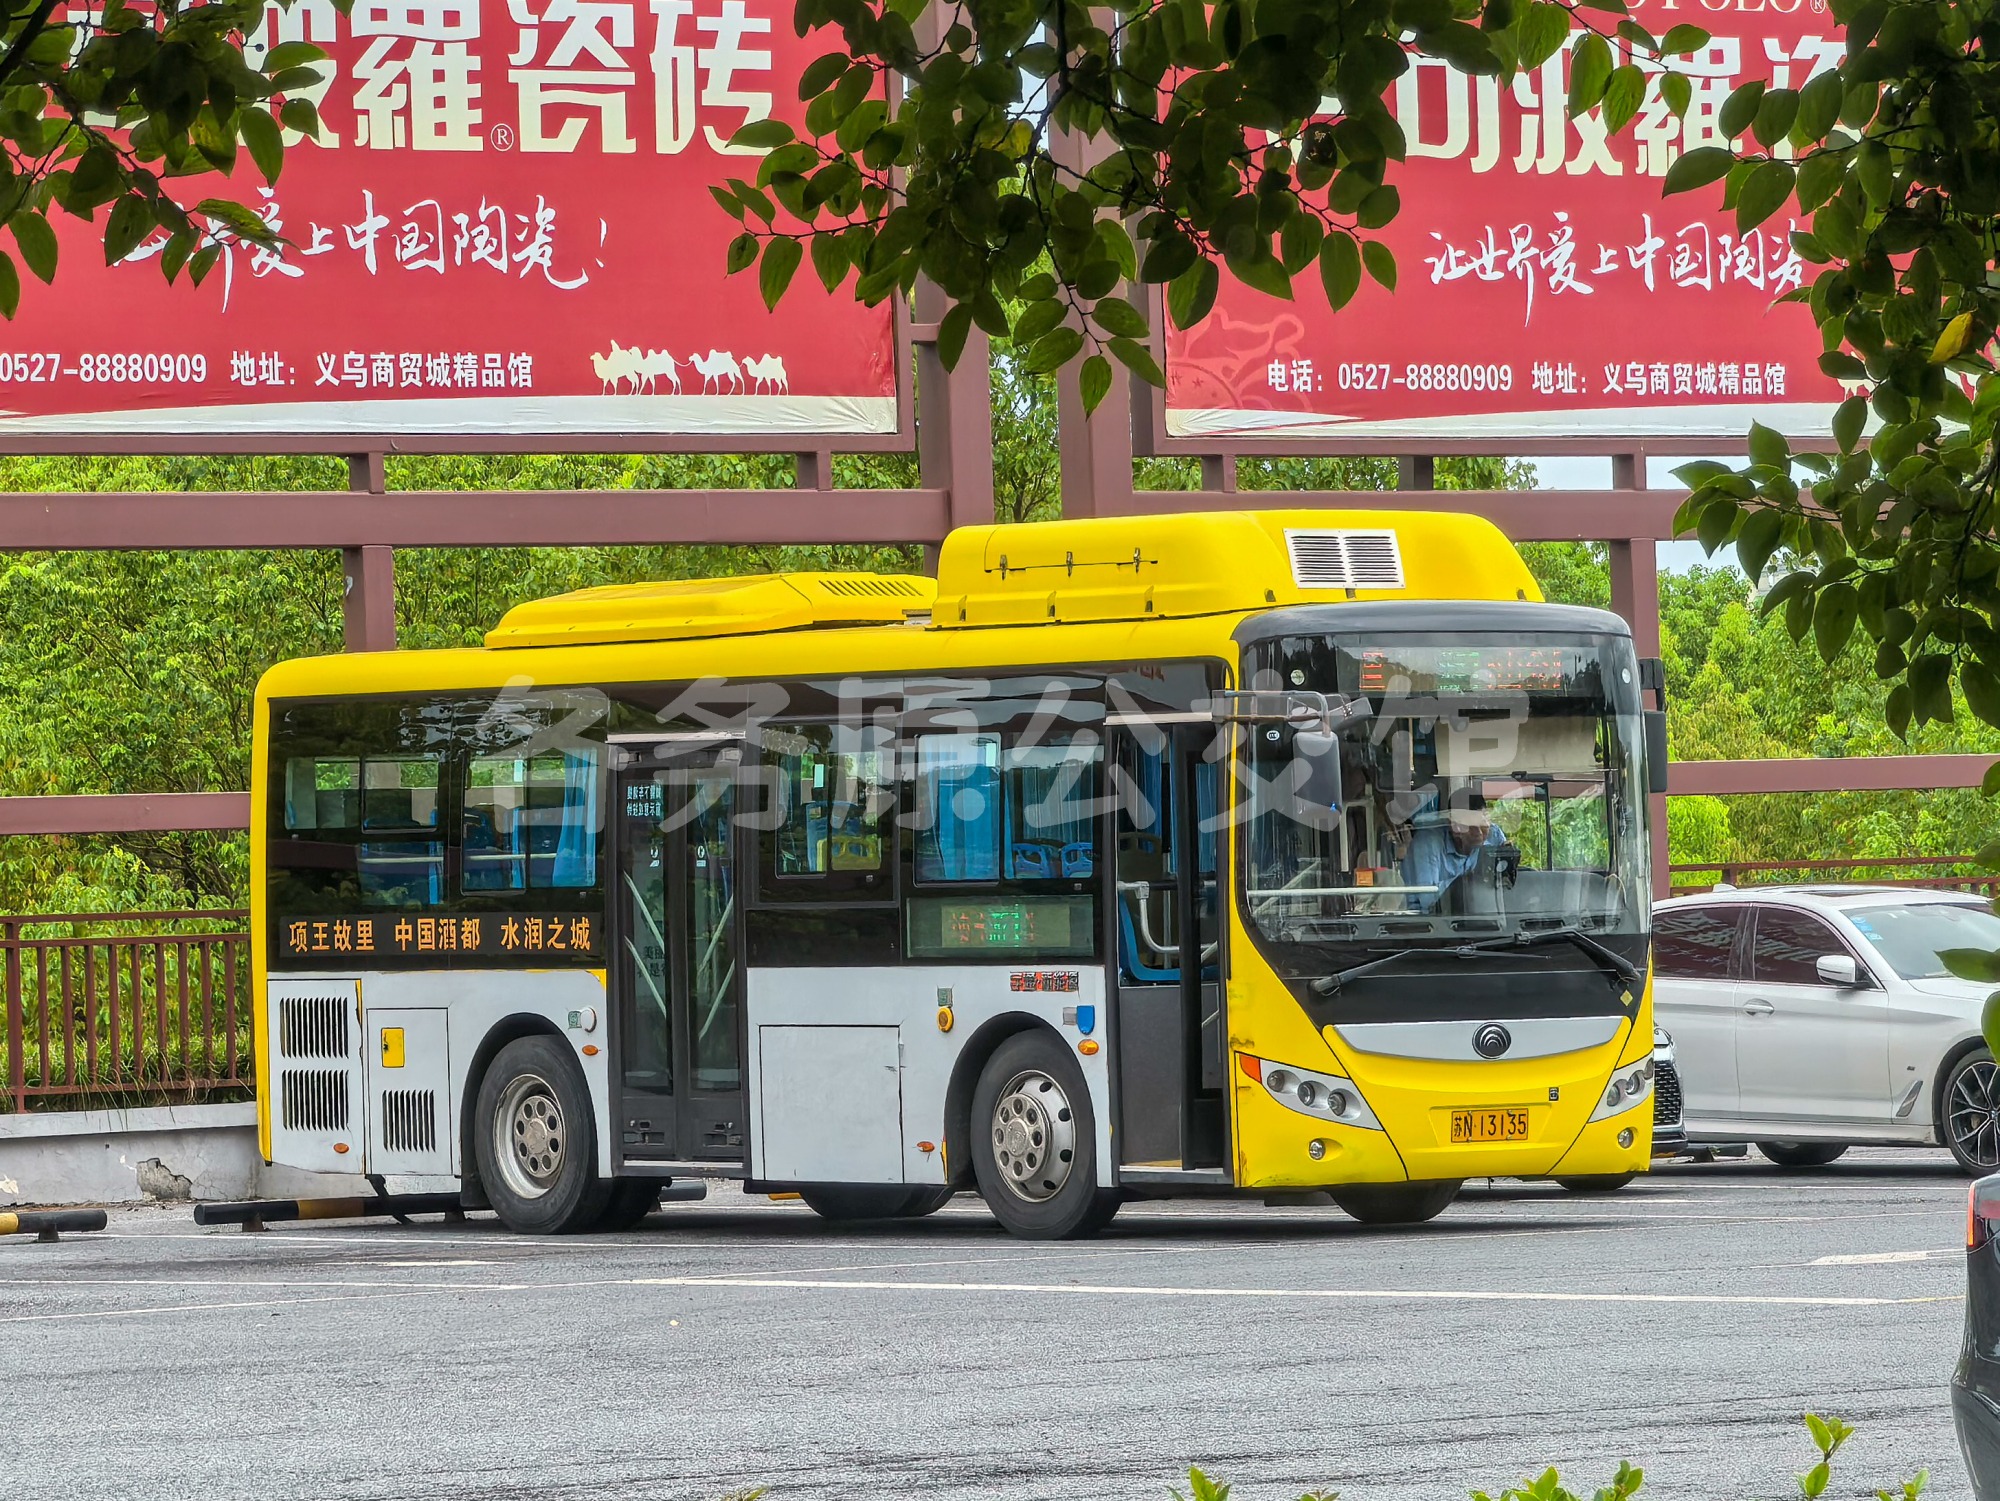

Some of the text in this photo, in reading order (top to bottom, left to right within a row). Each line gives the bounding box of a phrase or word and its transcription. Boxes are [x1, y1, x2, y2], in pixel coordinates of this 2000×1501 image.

[0, 350, 534, 388] 0527-88880909 地址： 义乌商贸城精品馆
[1267, 359, 1786, 396] 电话： 0527-88880909 地址： 义乌商贸城精品馆
[289, 916, 591, 952] 项王故里 中国酒都 水润之城
